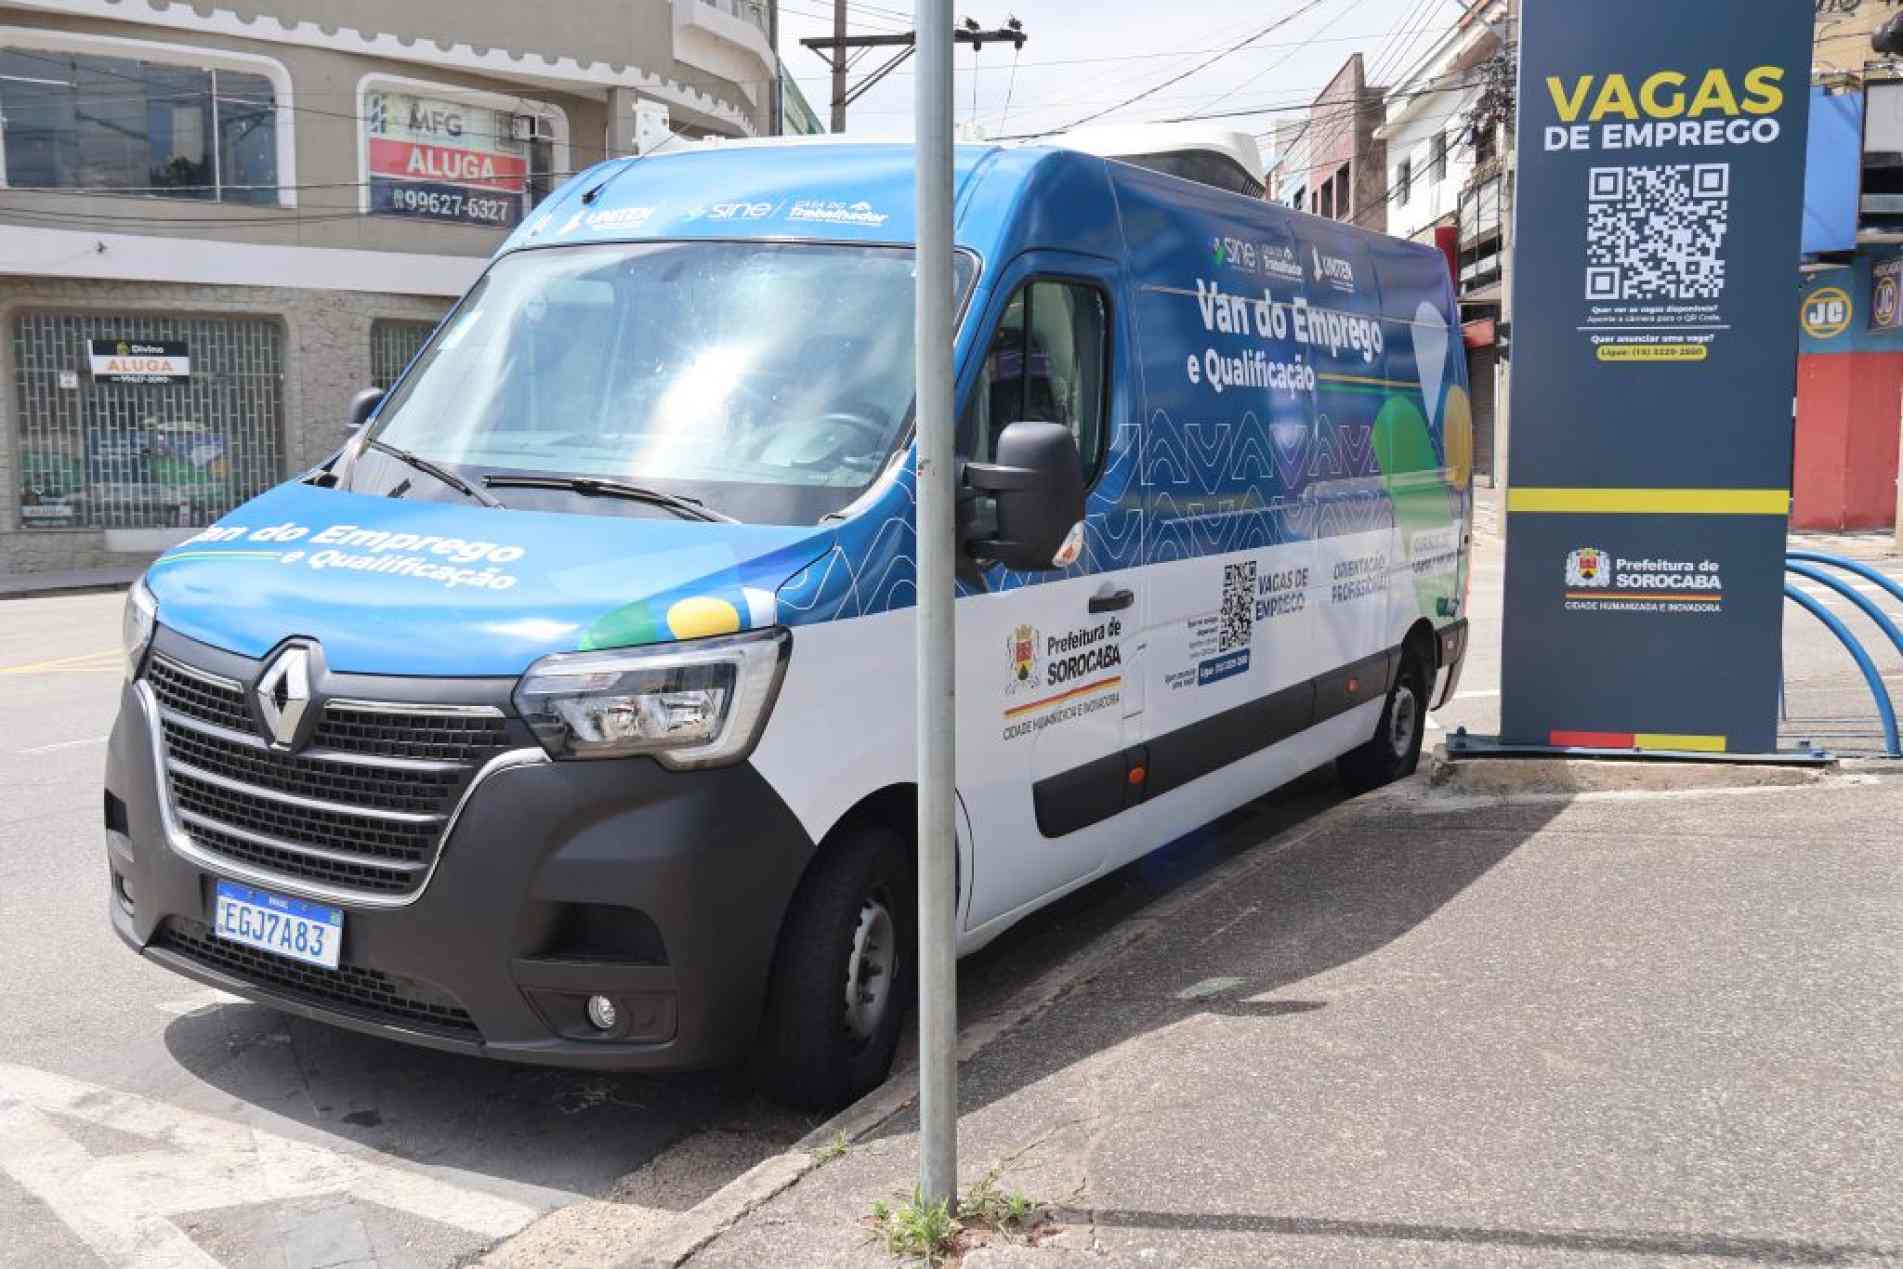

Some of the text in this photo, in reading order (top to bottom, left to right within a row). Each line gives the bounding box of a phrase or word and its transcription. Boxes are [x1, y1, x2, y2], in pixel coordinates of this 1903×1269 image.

[1545, 66, 1785, 122] VAGAS
[409, 103, 463, 137] MFG
[1544, 118, 1780, 151] DE EMPREGO
[406, 146, 498, 183] ALUGA
[1197, 278, 1383, 363] Van do Emprego
[1809, 302, 1843, 325] JC
[108, 359, 175, 373] ALUGA
[1187, 348, 1315, 399] e Qualificação
[248, 523, 310, 542] do
[309, 525, 525, 563] Emprego
[280, 549, 518, 590] e Qualificação
[1258, 567, 1310, 596] VAGAS DE
[1616, 559, 1720, 573] Prefeitura de
[1616, 574, 1722, 589] SOROCABA
[1255, 592, 1306, 621] EMPREGO
[1047, 616, 1121, 656] Prefeitura de
[1047, 641, 1121, 686] SOROCABA
[225, 903, 324, 956] EGJ7A83
